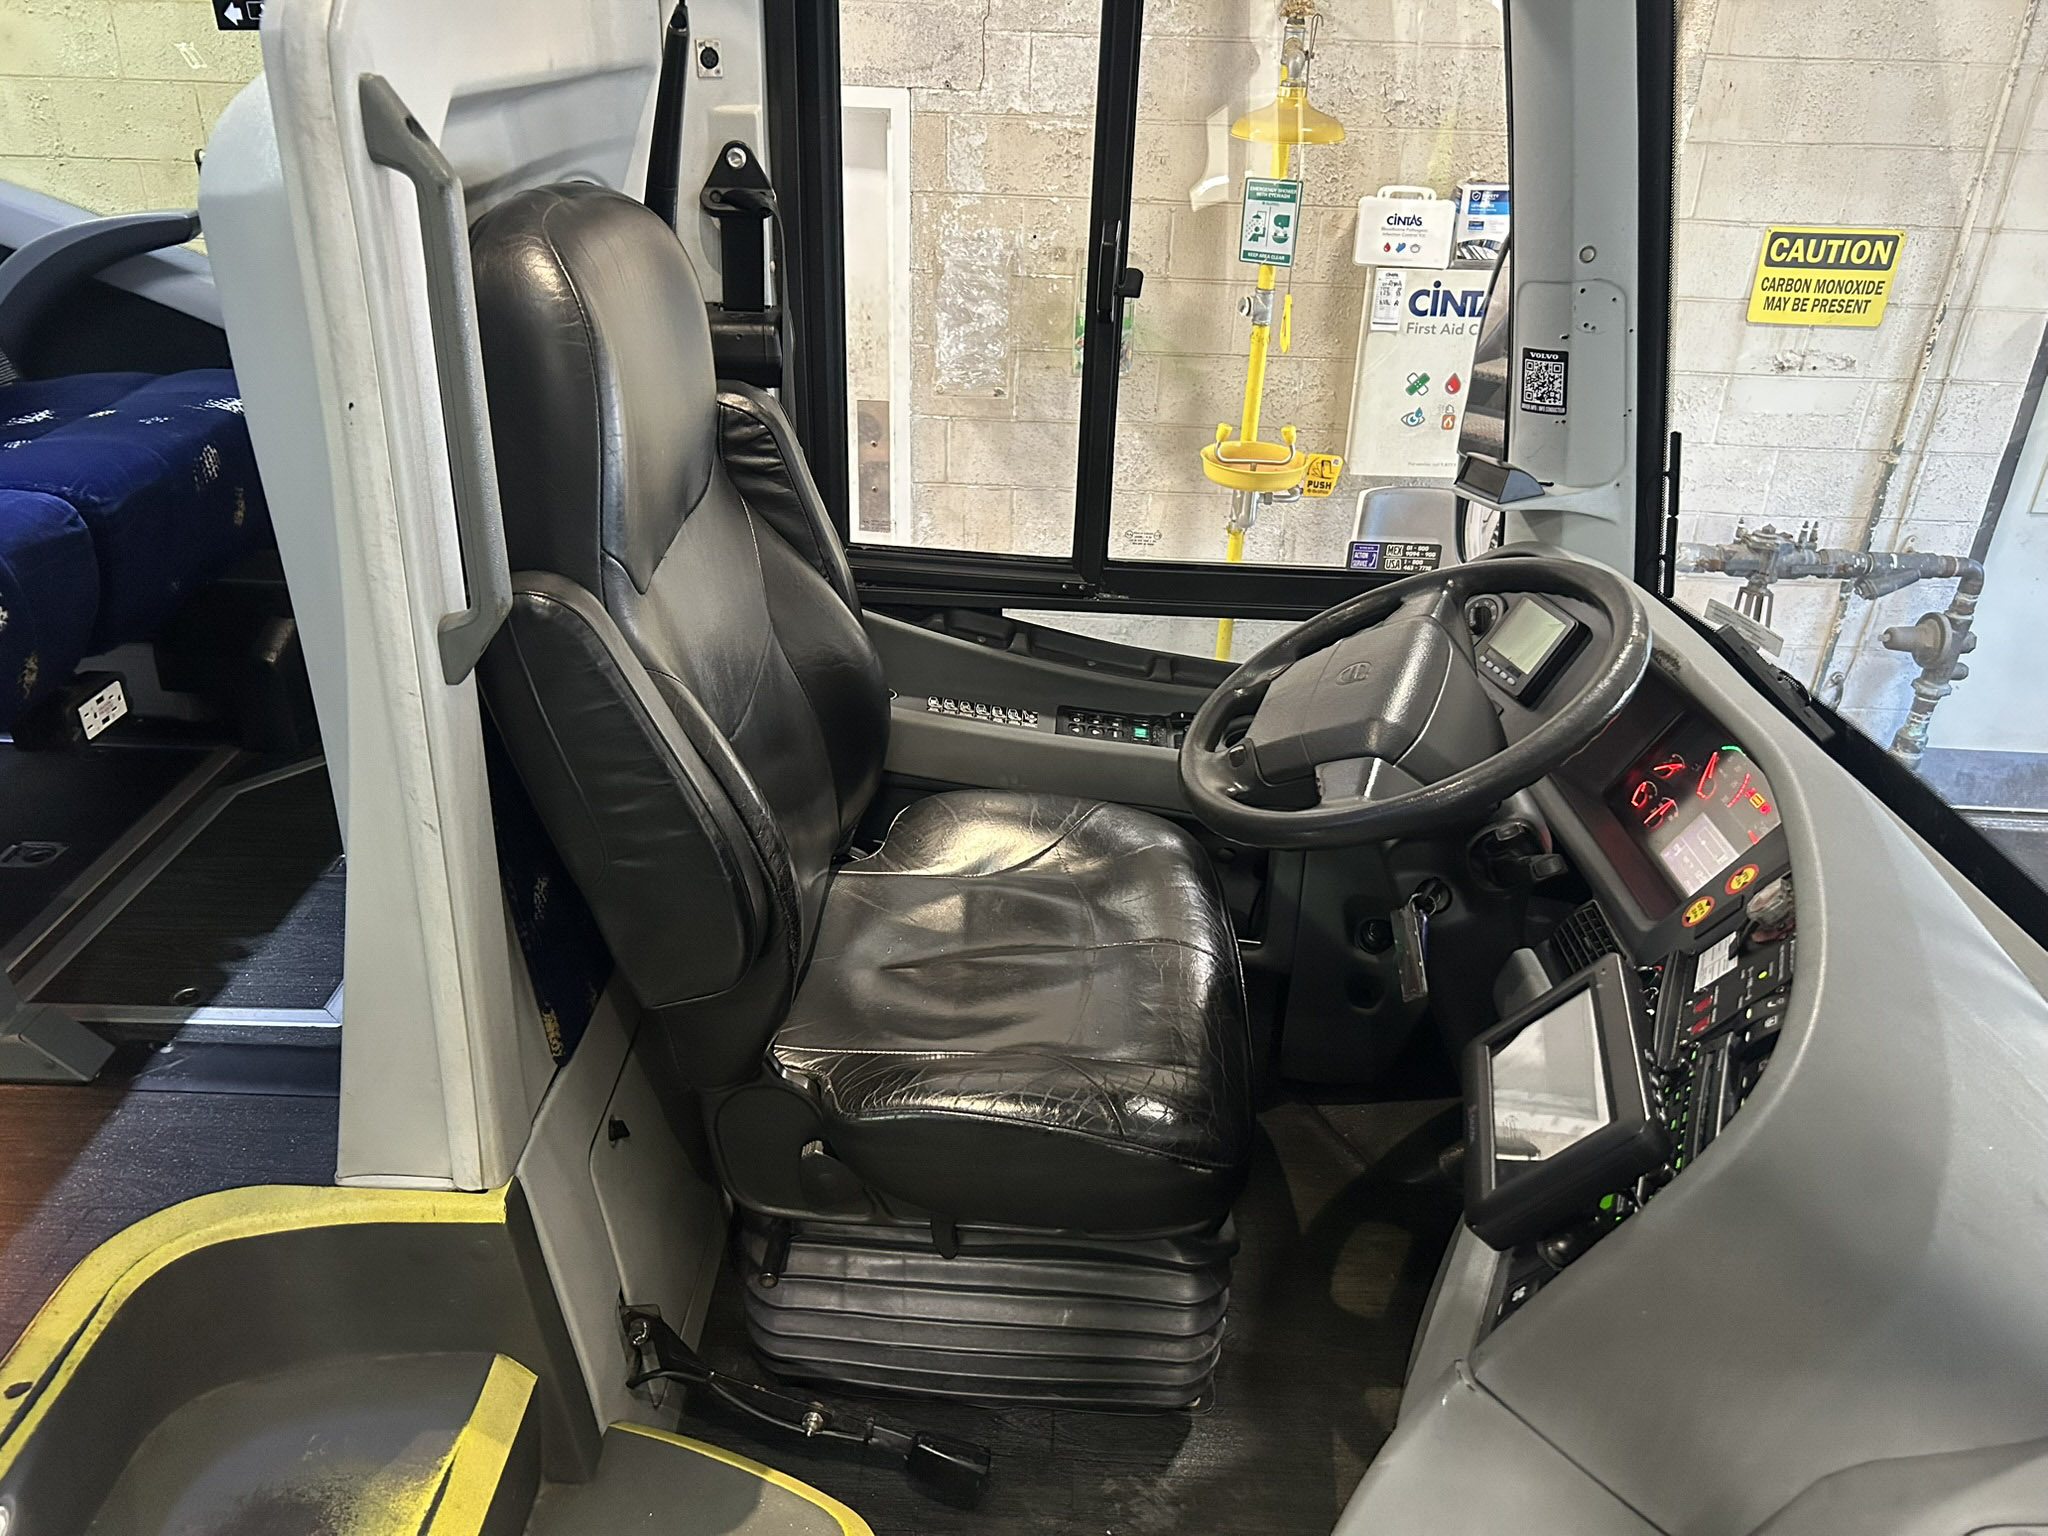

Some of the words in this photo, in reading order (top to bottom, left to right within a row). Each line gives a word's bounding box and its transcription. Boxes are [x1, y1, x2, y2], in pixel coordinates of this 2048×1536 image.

[1769, 237, 1894, 265] CAUTION
[1761, 276, 1812, 294] CARBON
[1813, 278, 1885, 296] MONOXIDE
[1763, 296, 1790, 312] MAY
[1791, 297, 1810, 312] BE
[1811, 298, 1872, 314] PRESENT
[1406, 322, 1436, 334] First
[1440, 323, 1464, 335] Aid
[1530, 352, 1559, 360] VOLVO
[1308, 480, 1332, 490] PUSH
[1386, 544, 1404, 556] MEX
[1385, 559, 1401, 570] USA
